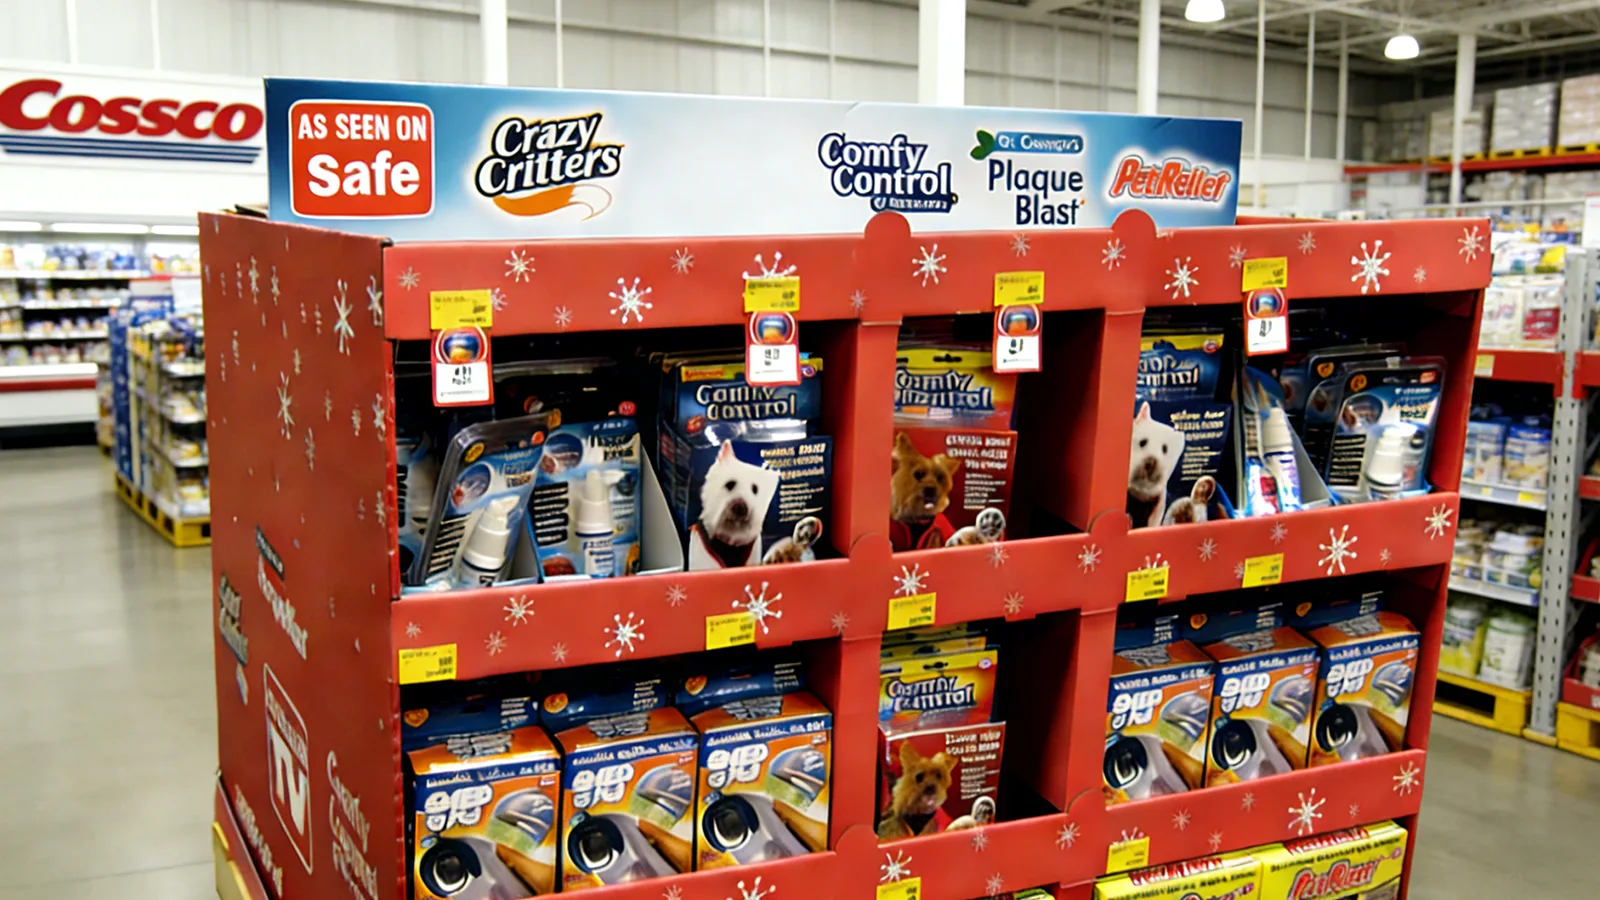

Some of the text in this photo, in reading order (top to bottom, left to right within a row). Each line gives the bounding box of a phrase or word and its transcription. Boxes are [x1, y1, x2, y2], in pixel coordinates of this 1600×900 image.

[0, 79, 263, 141] Cossco
[298, 113, 427, 141] AS SEEN ON
[493, 114, 601, 159] Crazy
[819, 133, 927, 173] Comfy
[307, 149, 420, 197] Safe
[476, 146, 620, 196] Critters
[832, 163, 951, 196] Control
[988, 159, 1083, 199] Plaque
[1016, 194, 1080, 225] Blast
